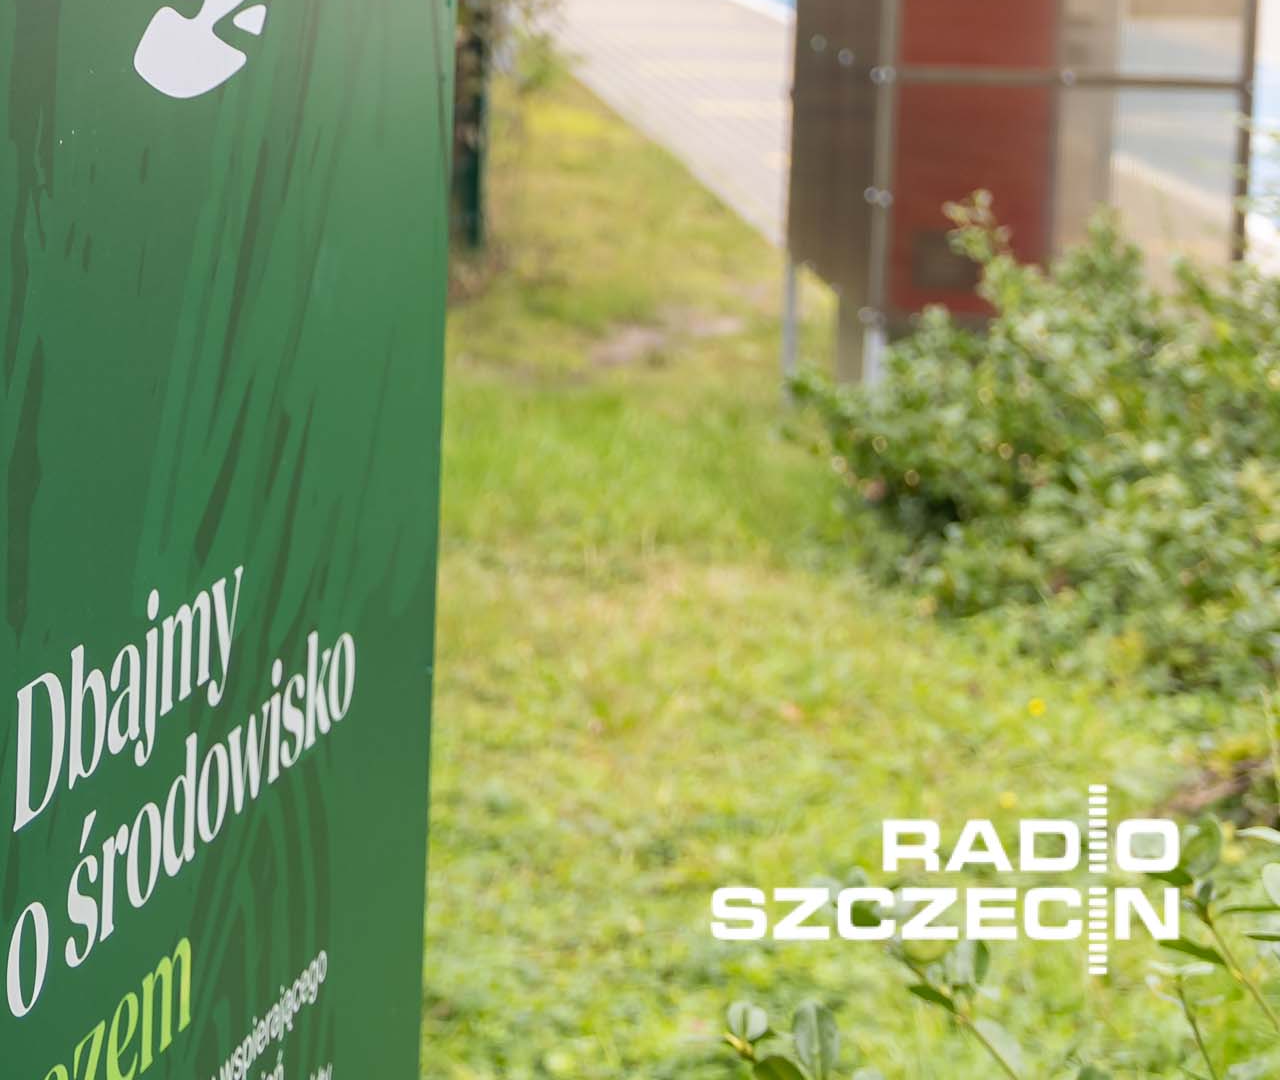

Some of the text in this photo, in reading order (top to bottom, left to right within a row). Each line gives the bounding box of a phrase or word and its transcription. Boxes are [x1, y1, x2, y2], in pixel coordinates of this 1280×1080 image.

[6, 630, 356, 1018] o środowisko
[13, 565, 243, 832] Dbajmy
[44, 937, 192, 1080] zem
